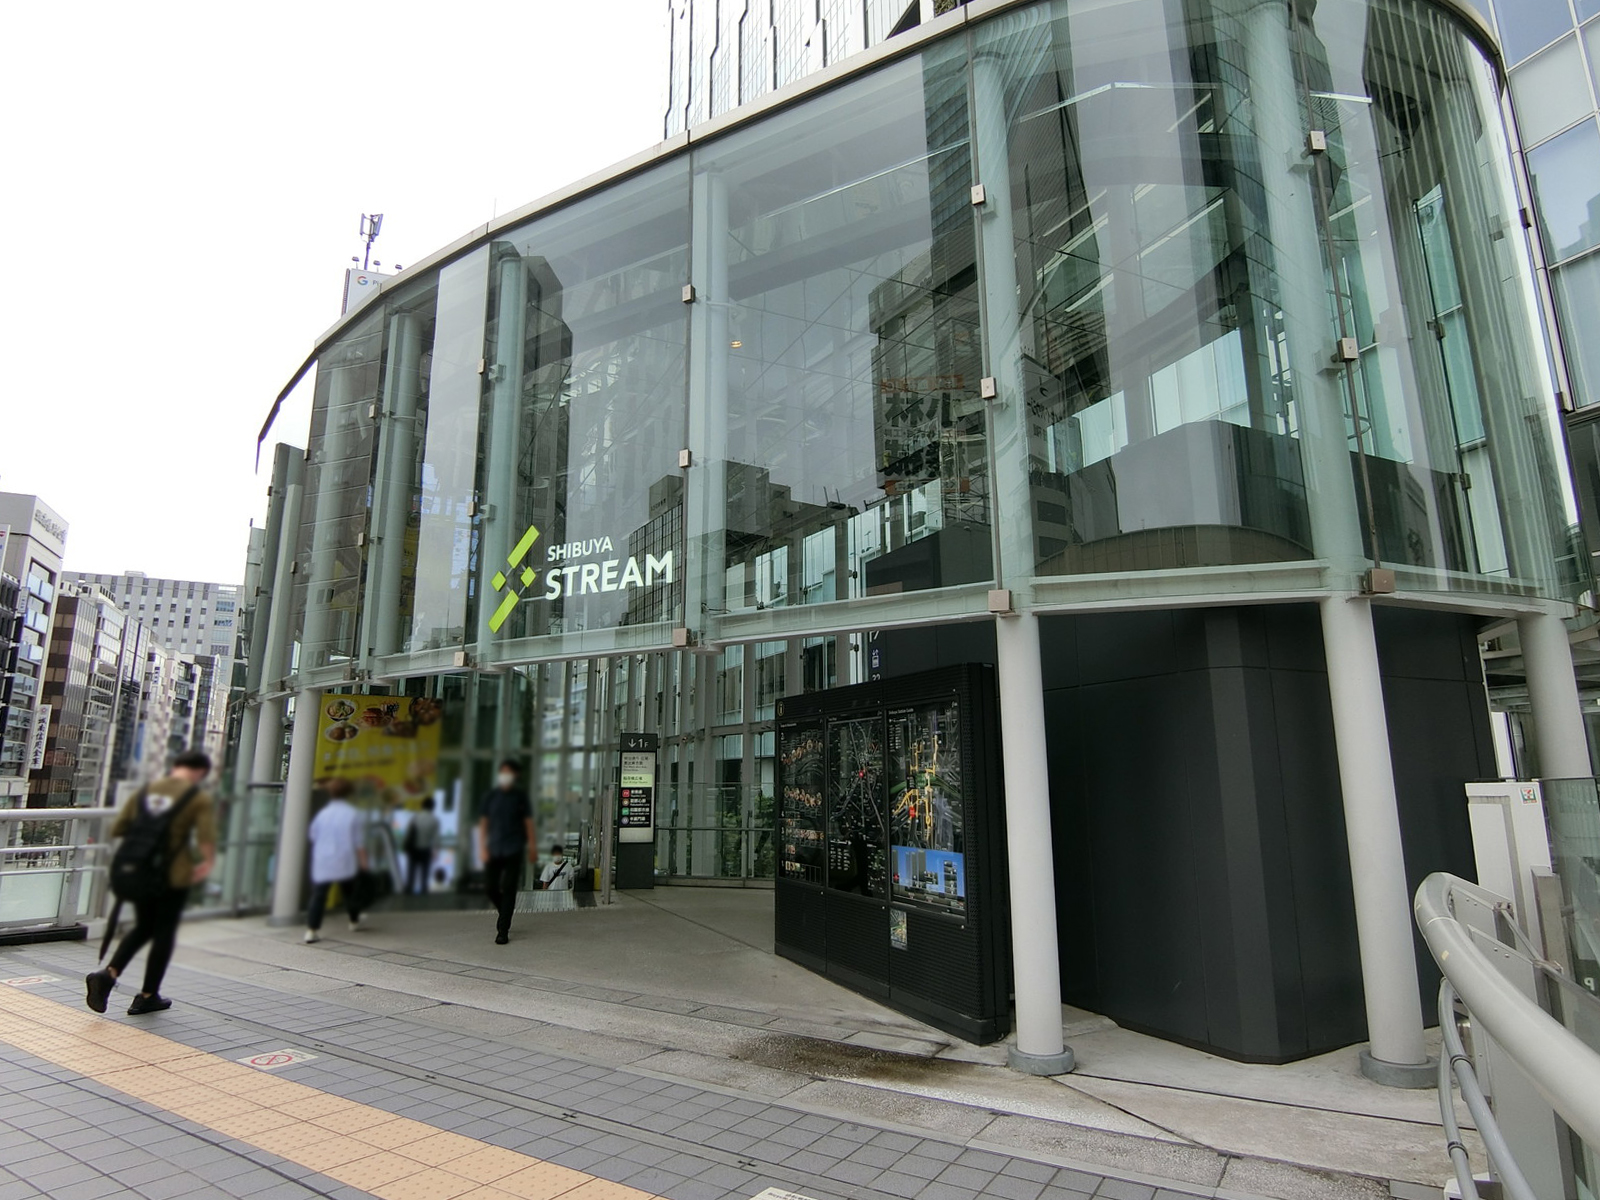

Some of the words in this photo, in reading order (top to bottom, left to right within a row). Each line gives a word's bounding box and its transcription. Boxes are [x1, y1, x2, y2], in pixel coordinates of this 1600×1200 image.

[547, 535, 613, 562] SHIBUYA
[545, 550, 673, 600] STREAM
[638, 738, 649, 748] 1F
